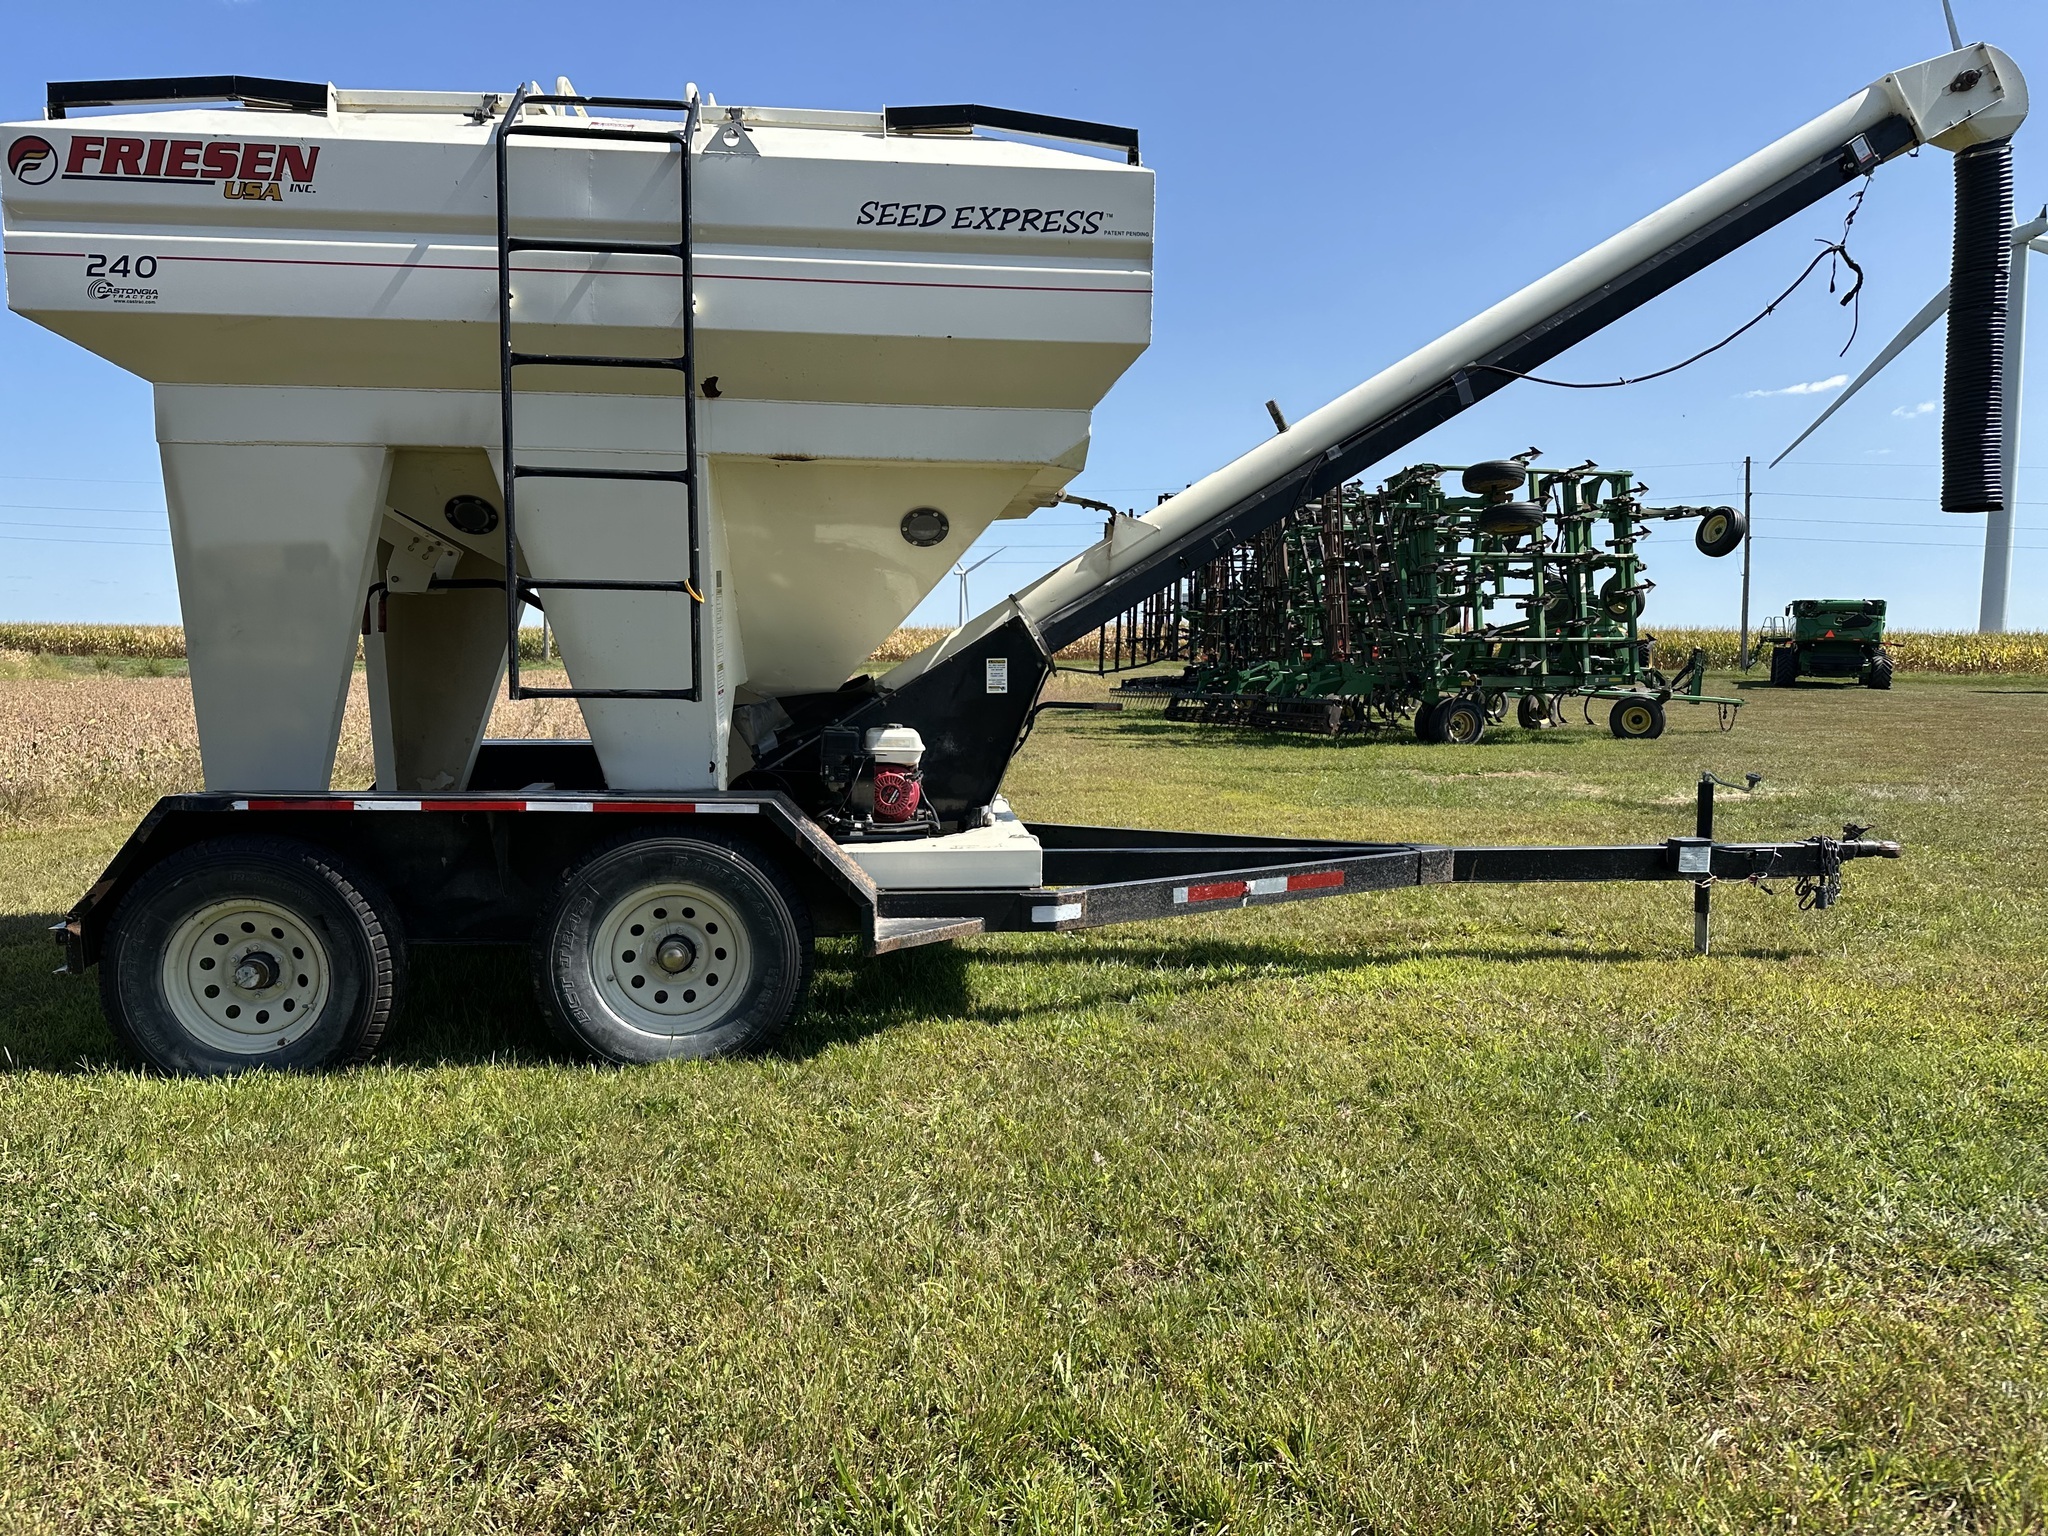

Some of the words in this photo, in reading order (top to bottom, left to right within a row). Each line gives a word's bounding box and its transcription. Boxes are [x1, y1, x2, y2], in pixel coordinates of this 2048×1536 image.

[65, 135, 321, 183] FRIESEN
[223, 180, 284, 202] USA
[289, 183, 317, 194] INC.
[856, 200, 947, 228] SEED
[951, 206, 1104, 235] EXPRESS
[1125, 230, 1150, 238] PENDING
[86, 253, 158, 279] 240
[97, 286, 159, 295] CASTONGIA
[559, 976, 592, 1024] BCT
